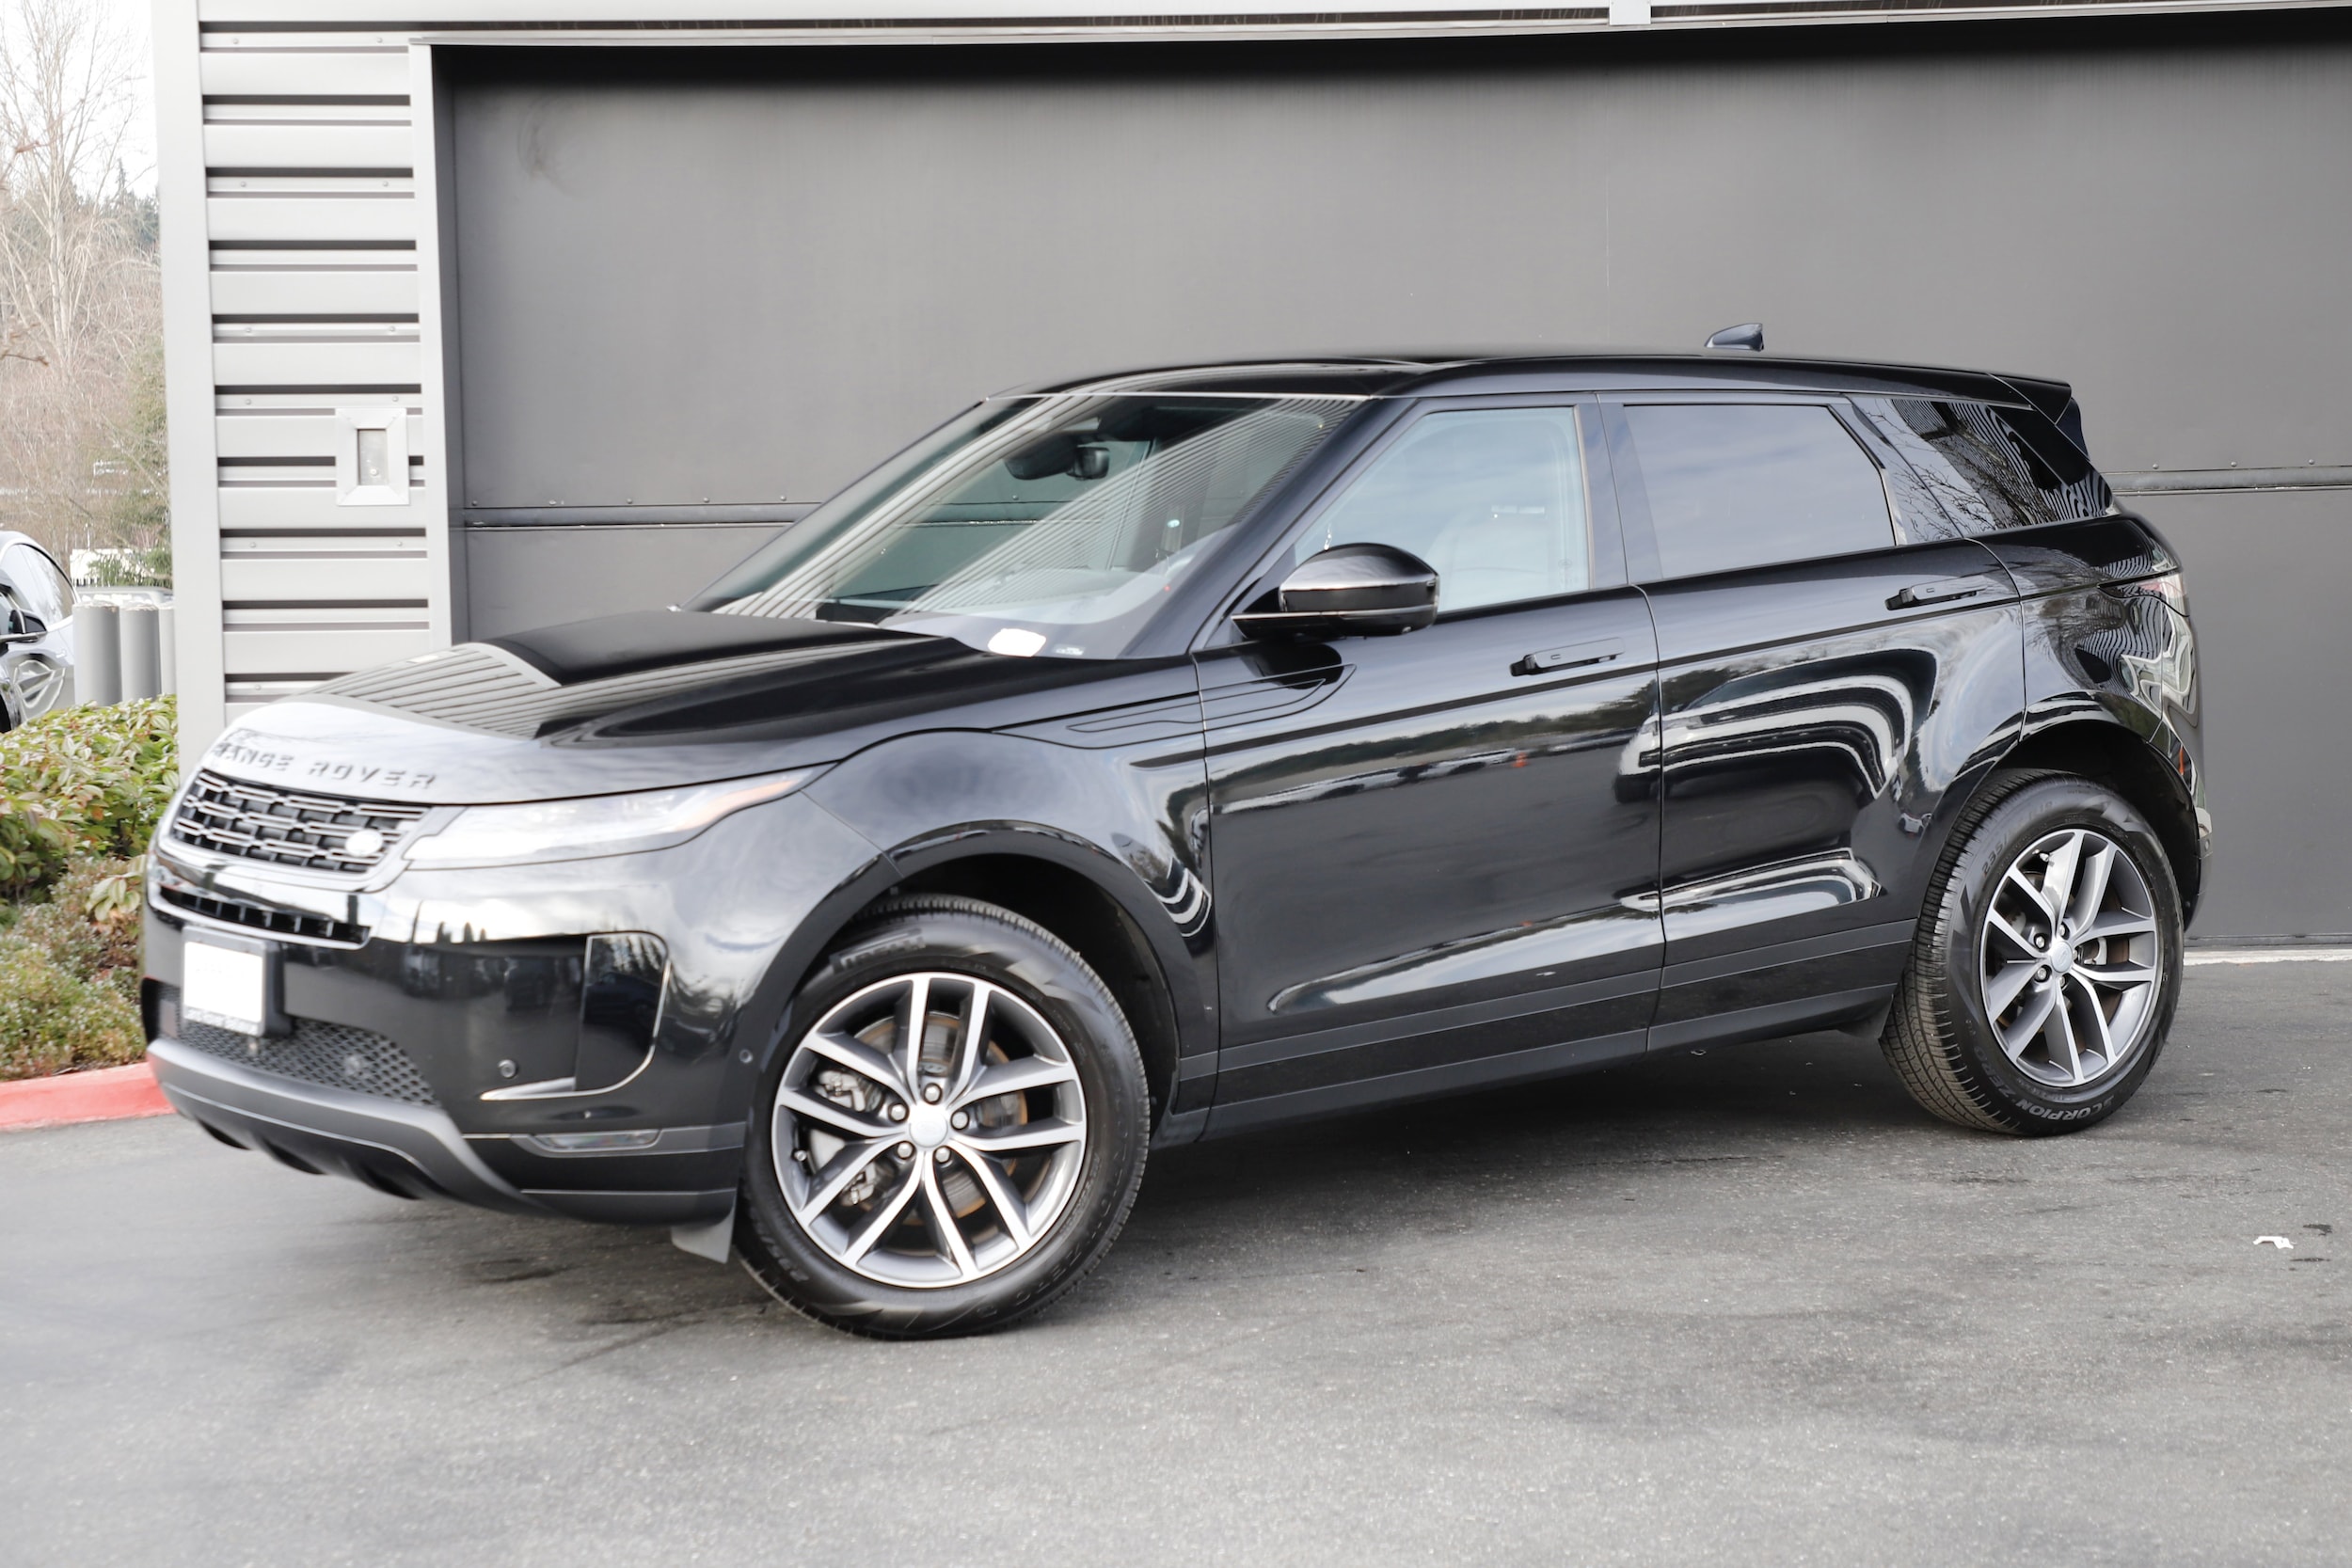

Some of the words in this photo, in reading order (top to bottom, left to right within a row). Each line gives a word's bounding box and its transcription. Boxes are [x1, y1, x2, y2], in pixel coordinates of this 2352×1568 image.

[212, 741, 294, 772] RANGE
[308, 760, 437, 791] ROVER
[1973, 1046, 2016, 1098] ZERO
[2015, 1095, 2115, 1121] SCORPION
